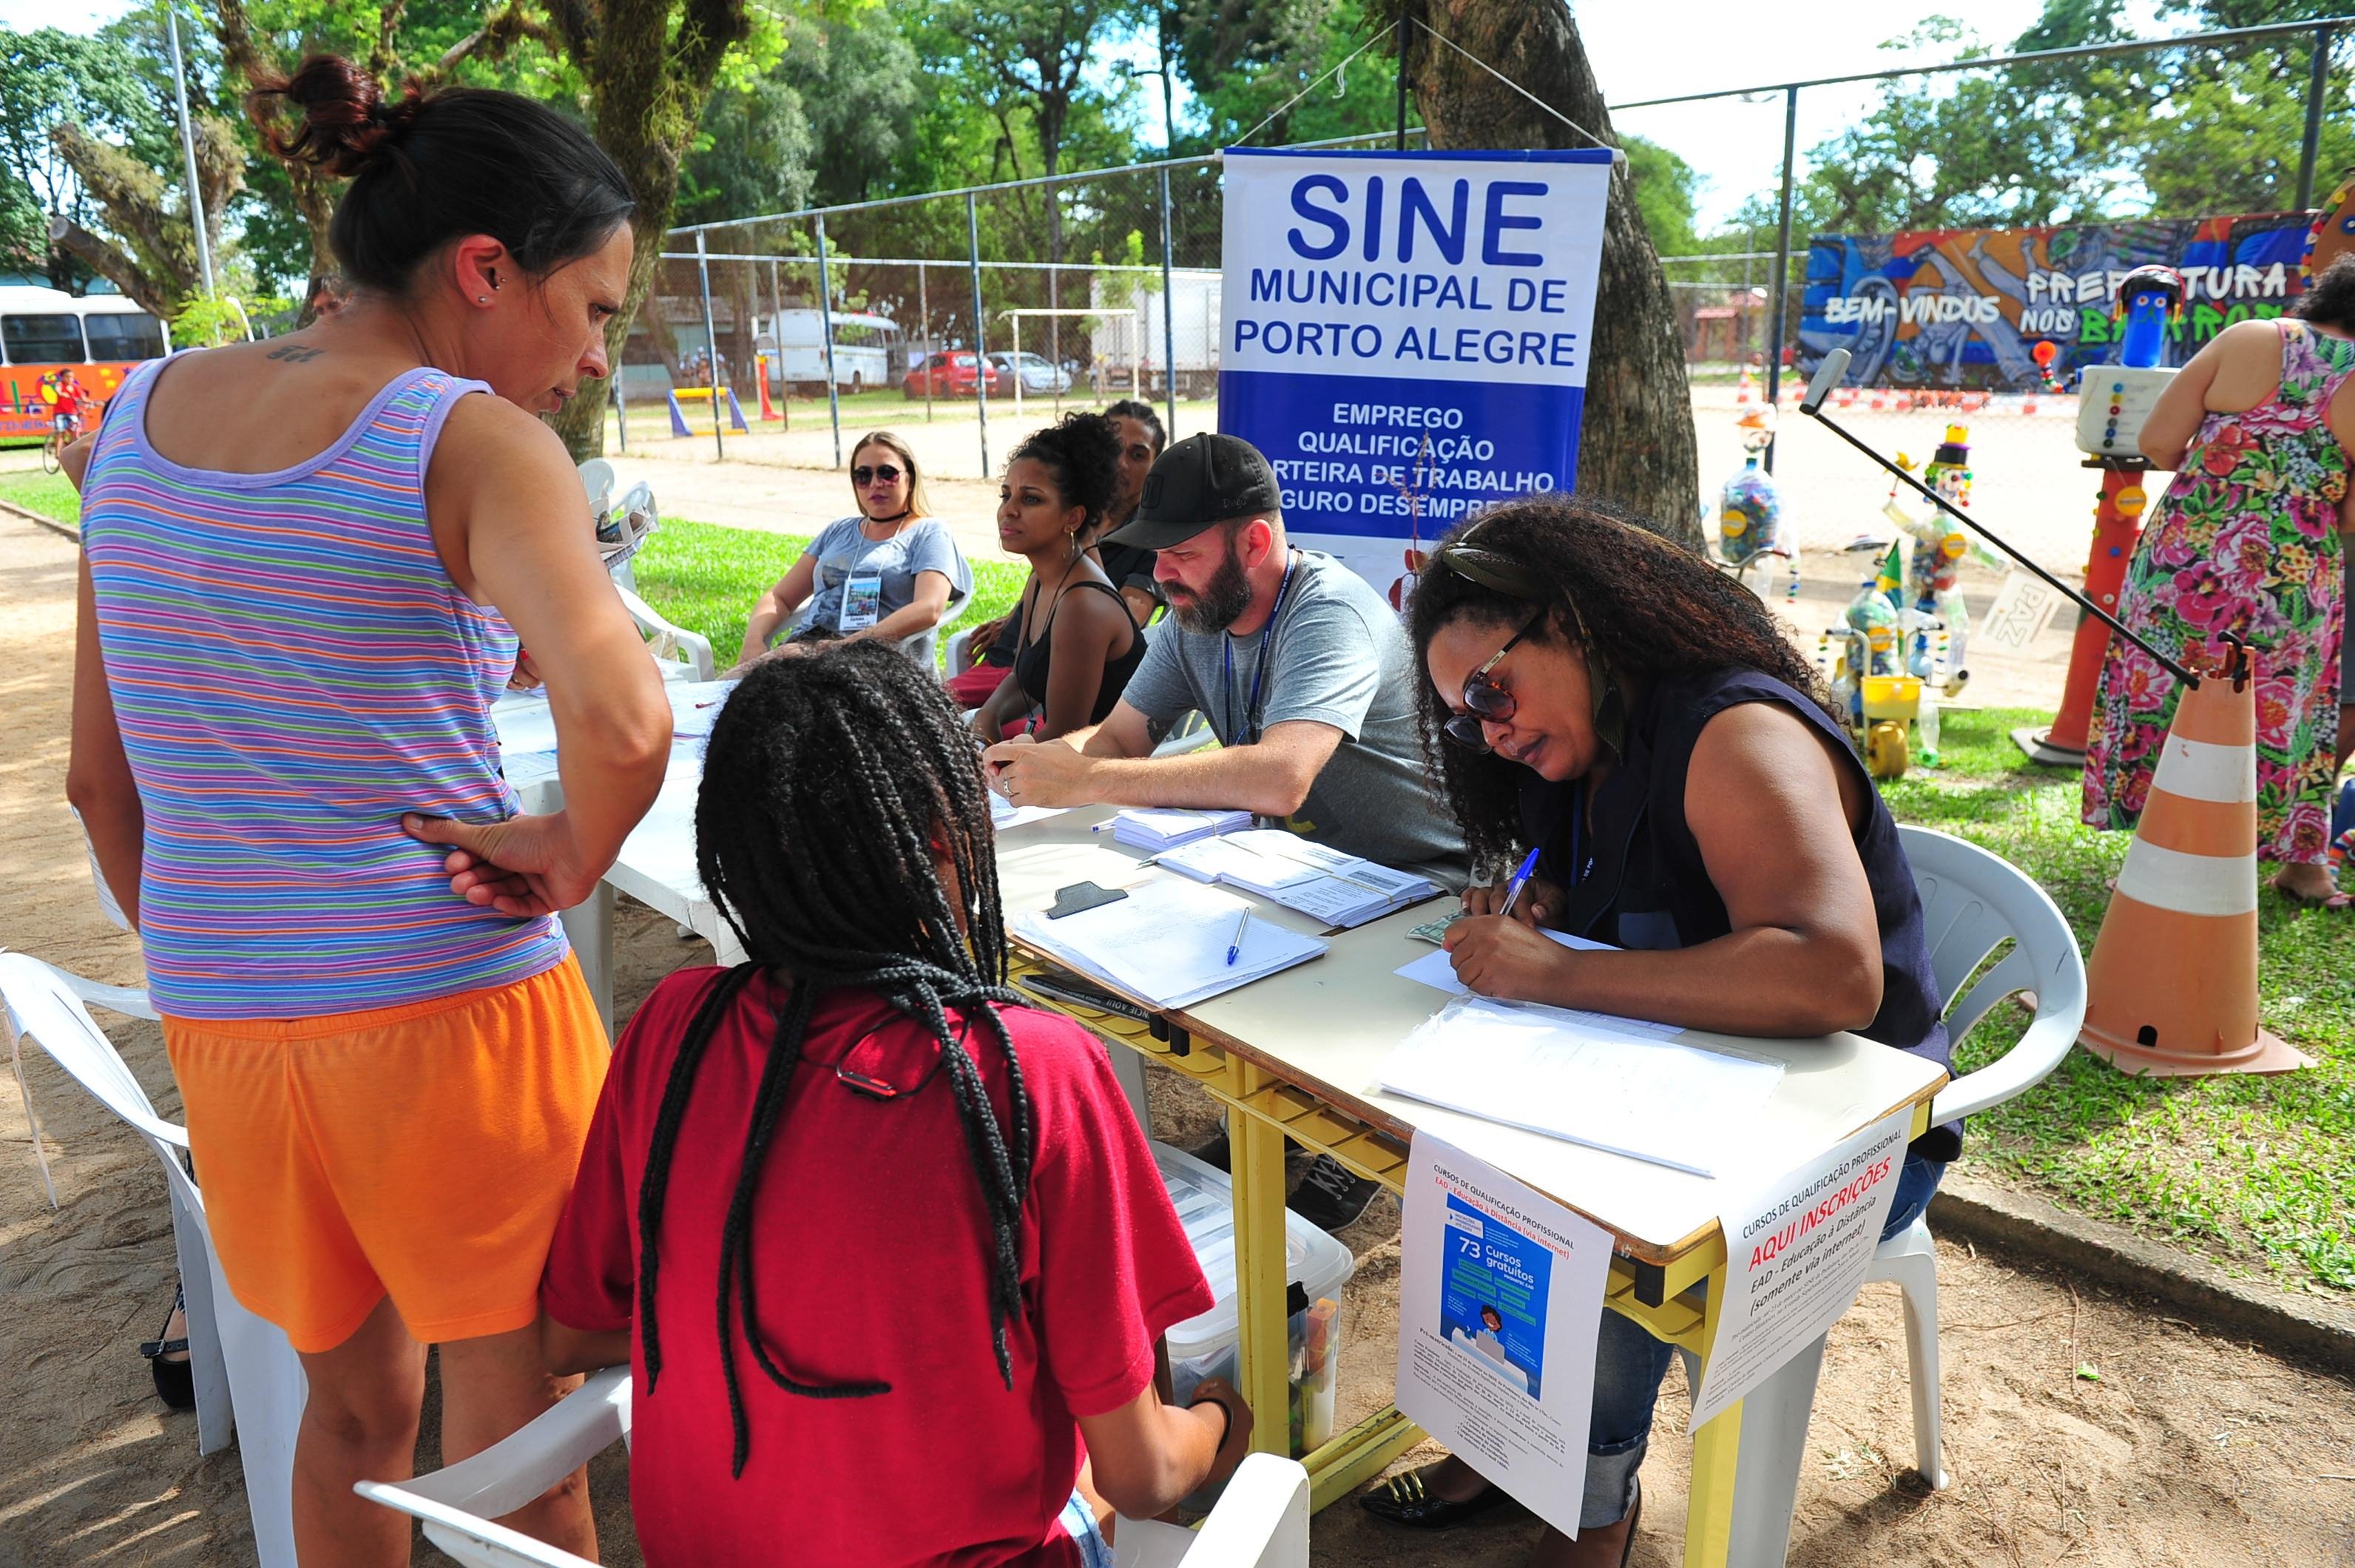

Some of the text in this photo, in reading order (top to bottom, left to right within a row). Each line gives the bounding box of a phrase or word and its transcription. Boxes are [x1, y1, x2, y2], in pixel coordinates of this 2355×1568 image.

[1288, 175, 1549, 267] SINE
[1251, 268, 1567, 314] MUNICIPAL DE
[2026, 262, 2287, 305] PREFTURA
[1234, 320, 1577, 366] PORTO ALEGRE
[1333, 403, 1464, 430] EMPREGO
[1298, 431, 1495, 464] QUALIFICAÇÃO
[1272, 459, 1554, 494] RTEIRA DE TRABALHO
[1280, 489, 1354, 513] GURO
[1996, 583, 2048, 648] PAZ
[1433, 1164, 1459, 1183] CURSOS
[1460, 1179, 1470, 1190] DE
[1470, 1186, 1521, 1220] QUALIFICAÇÃO
[1522, 1214, 1575, 1250] PROFISSIONAL
[1743, 1129, 1902, 1240] CURSOS DE QUALIFICAÇÃO PROFISSIONAL
[1435, 1177, 1448, 1190] EAD
[1453, 1188, 1483, 1210] Educação
[1490, 1209, 1522, 1232] Distância
[1523, 1227, 1536, 1243] (via
[1537, 1235, 1570, 1260] internet)
[1748, 1156, 1891, 1273] AQUI INSCRIÇÕES
[1459, 1236, 1481, 1259] 73
[1485, 1245, 1521, 1268] Cursos
[1750, 1268, 1802, 1317] (somente
[1805, 1255, 1820, 1274] via
[1822, 1219, 1866, 1263] internet)
[1751, 1269, 1773, 1294] EAD
[1781, 1231, 1827, 1273] Educação
[1828, 1225, 1834, 1239] à
[1836, 1196, 1876, 1234] Distância
[1486, 1257, 1535, 1284] gratuitos
